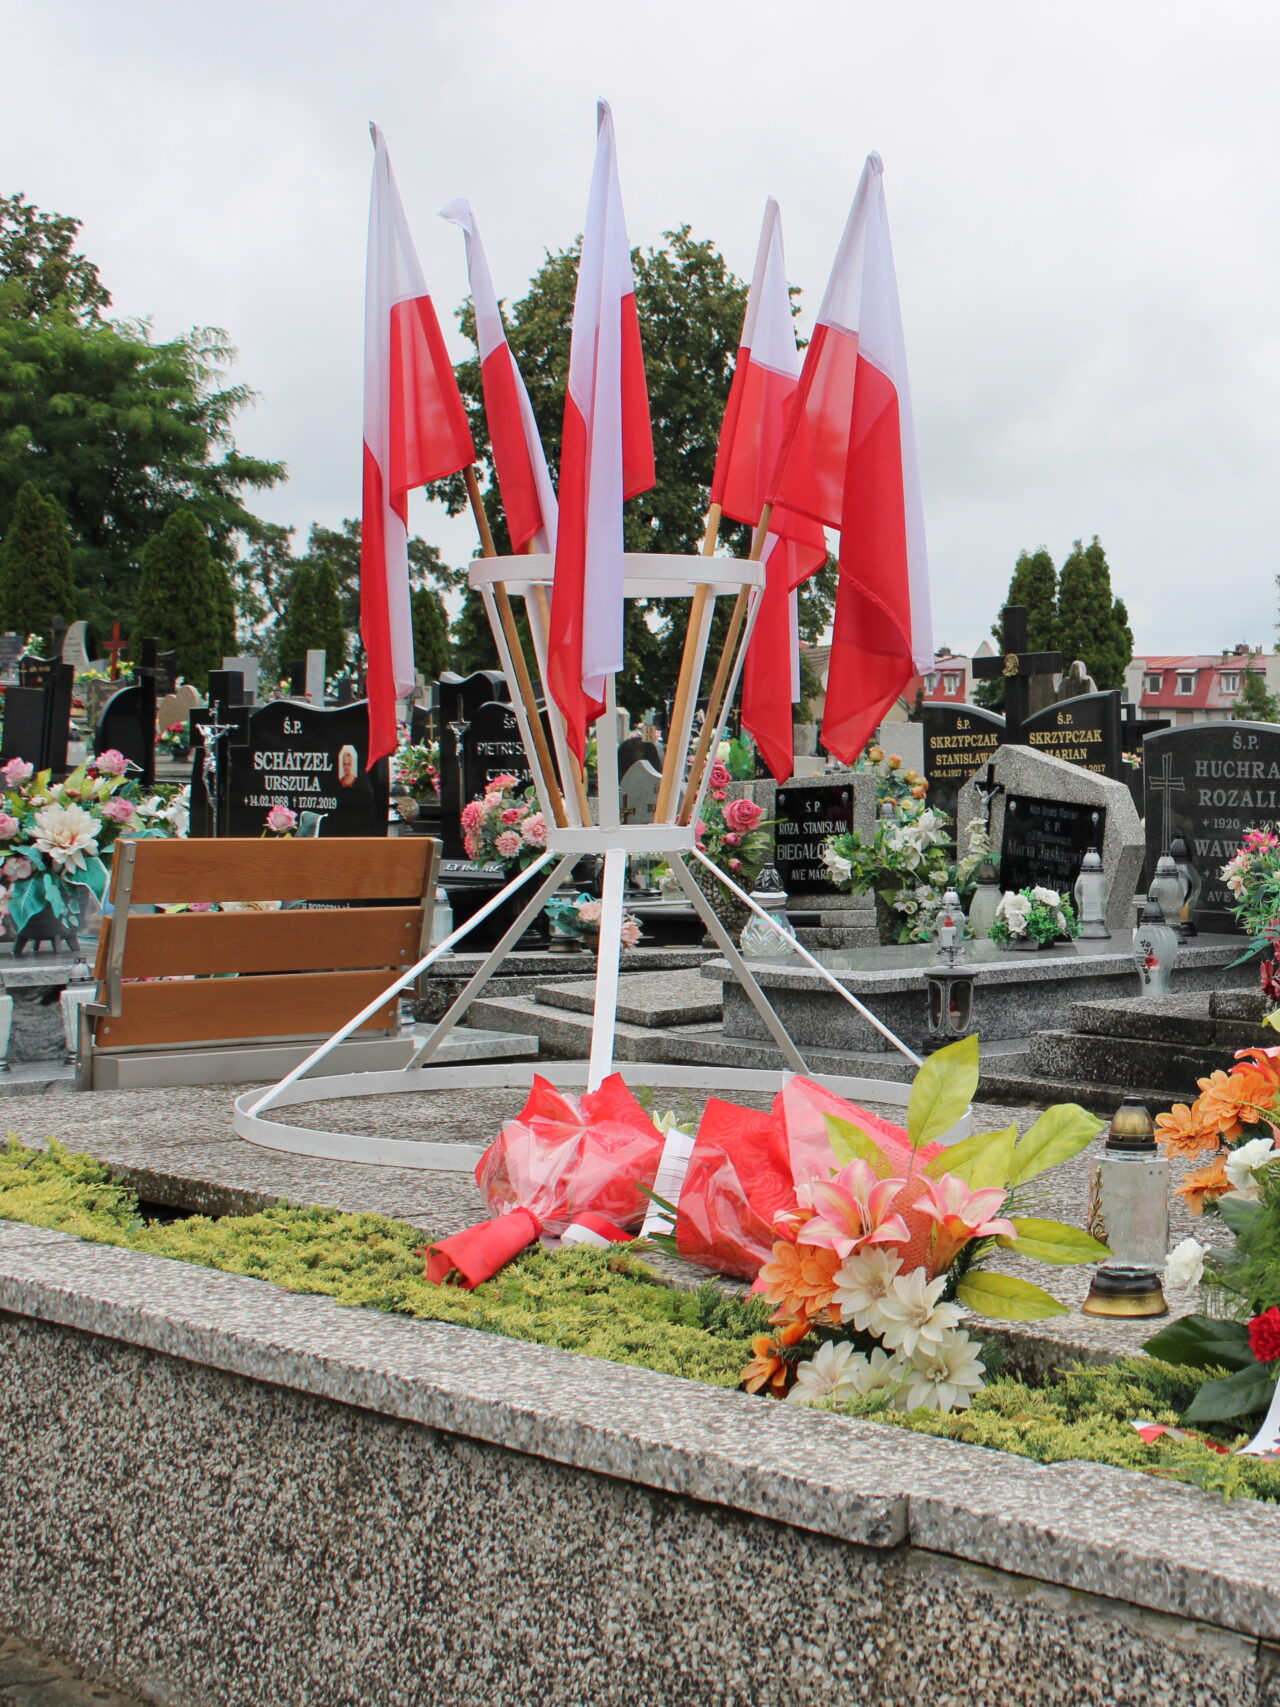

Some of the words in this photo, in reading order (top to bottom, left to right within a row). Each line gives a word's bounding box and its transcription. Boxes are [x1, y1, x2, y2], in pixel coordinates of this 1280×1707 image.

[283, 716, 303, 734] Ś.P.
[1057, 711, 1074, 725] Ś.P.
[930, 733, 999, 749] SKRZYPCZAK
[1029, 729, 1103, 746] SKRZYPCZAK
[1232, 731, 1260, 750] Ś.P.
[264, 775, 321, 792] URSZULA
[1213, 817, 1240, 830] 1920
[777, 842, 828, 861] BIEGAŁO
[1206, 890, 1232, 903] AVE
